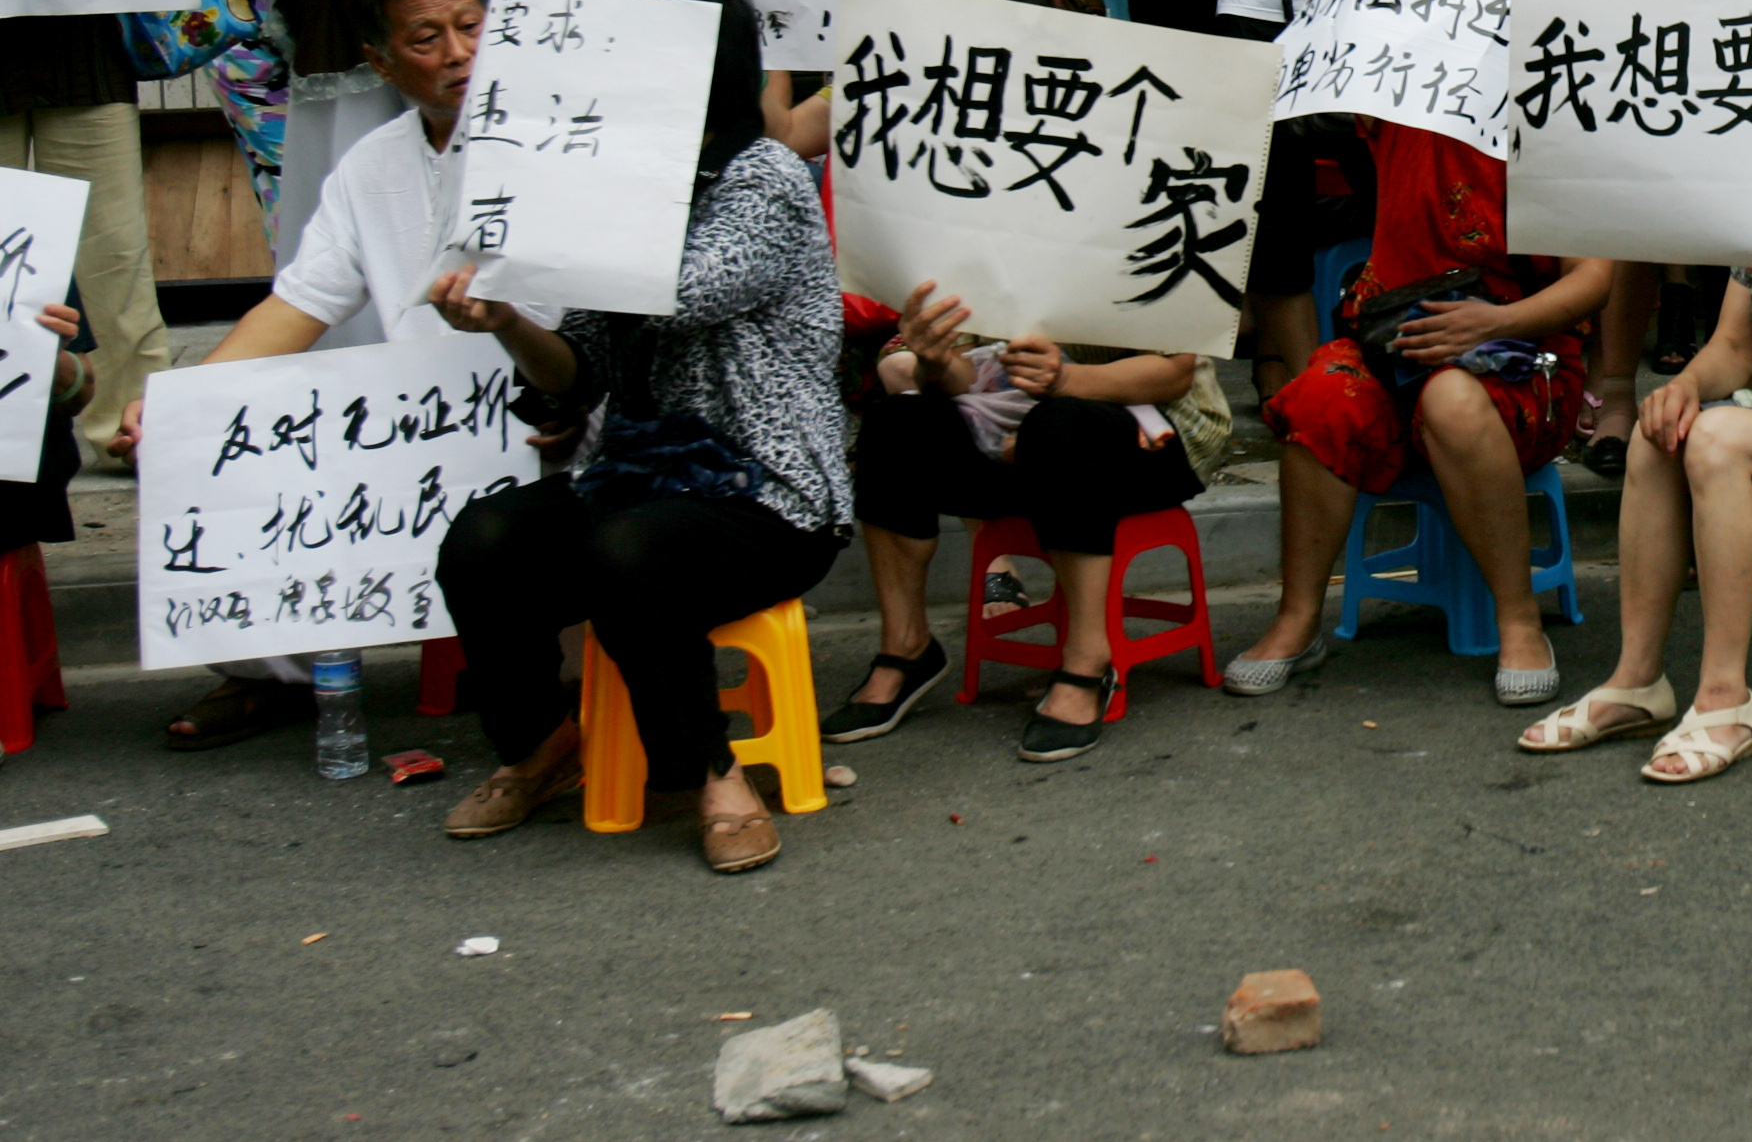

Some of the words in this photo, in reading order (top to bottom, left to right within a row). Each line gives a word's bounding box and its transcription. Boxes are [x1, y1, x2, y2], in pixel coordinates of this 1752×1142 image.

[834, 31, 1249, 310] 我想要个家
[163, 464, 520, 574] 迁、扰乱民
